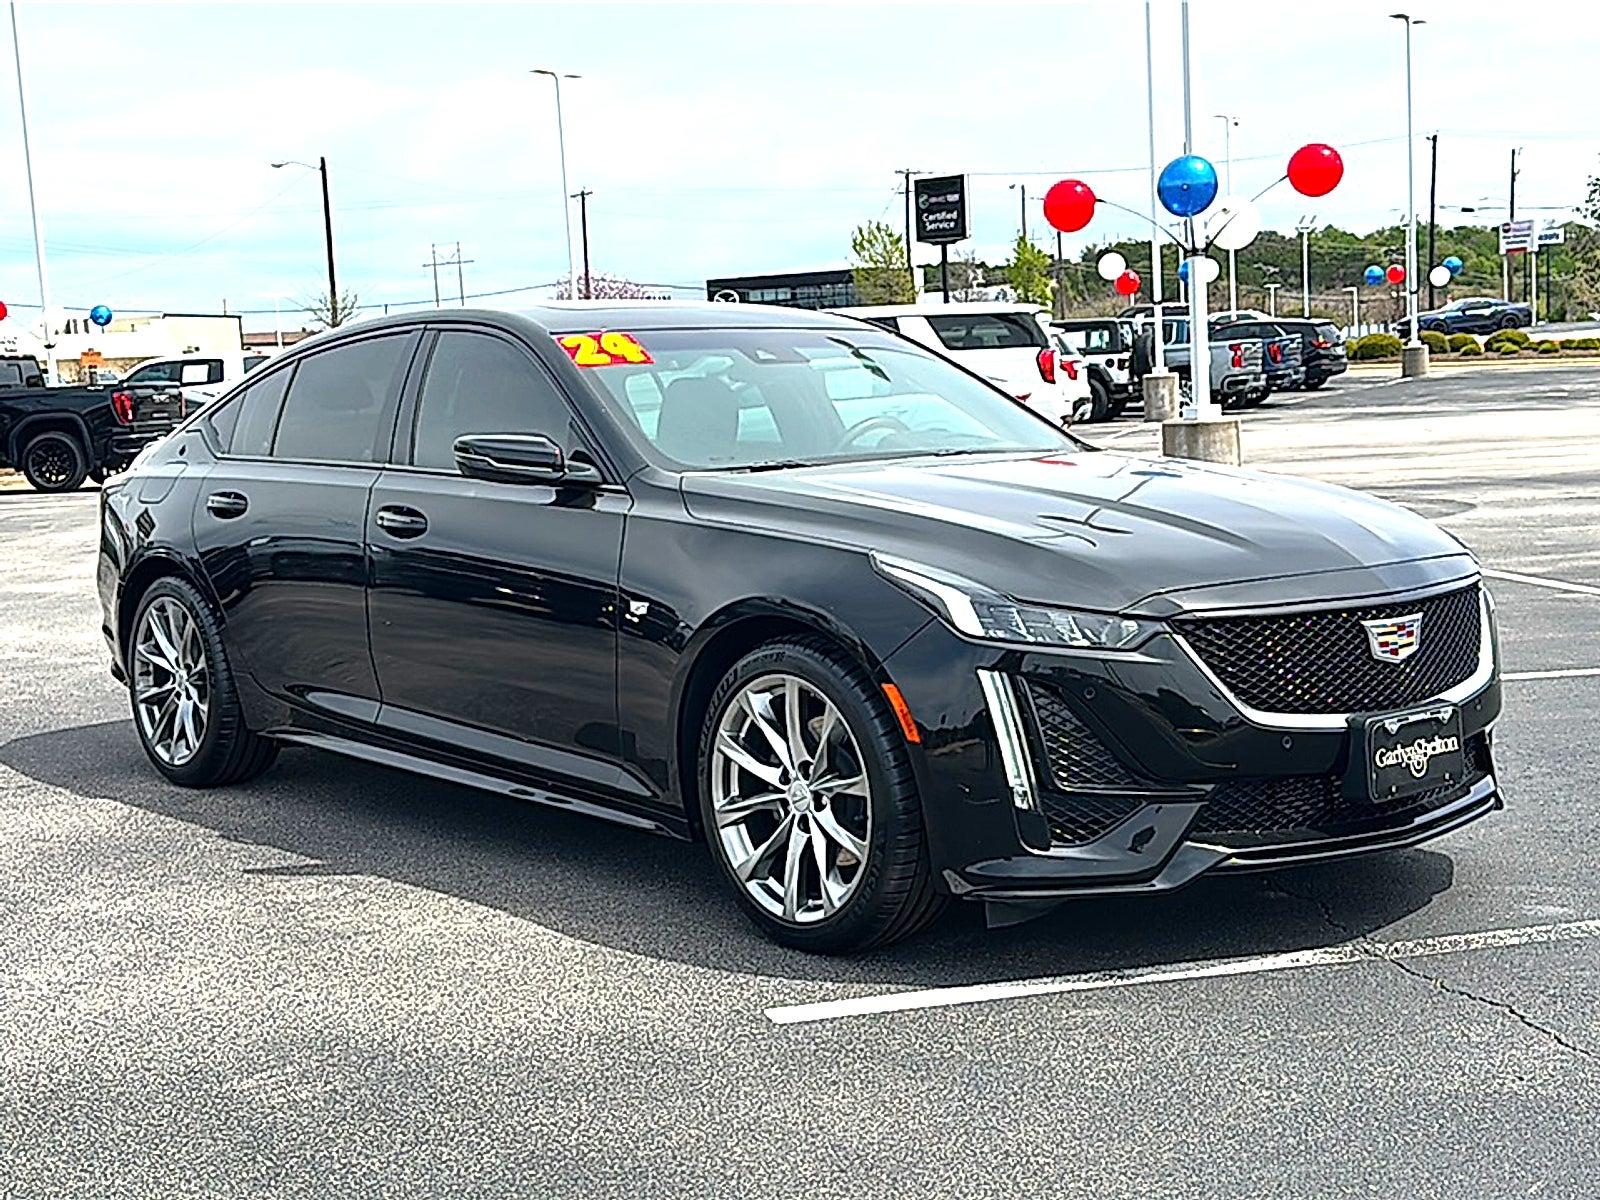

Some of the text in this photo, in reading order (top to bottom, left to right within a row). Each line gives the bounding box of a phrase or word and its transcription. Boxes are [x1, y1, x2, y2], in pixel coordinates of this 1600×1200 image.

[922, 210, 957, 221] Certified
[925, 221, 955, 231] Service
[560, 333, 646, 364] 24
